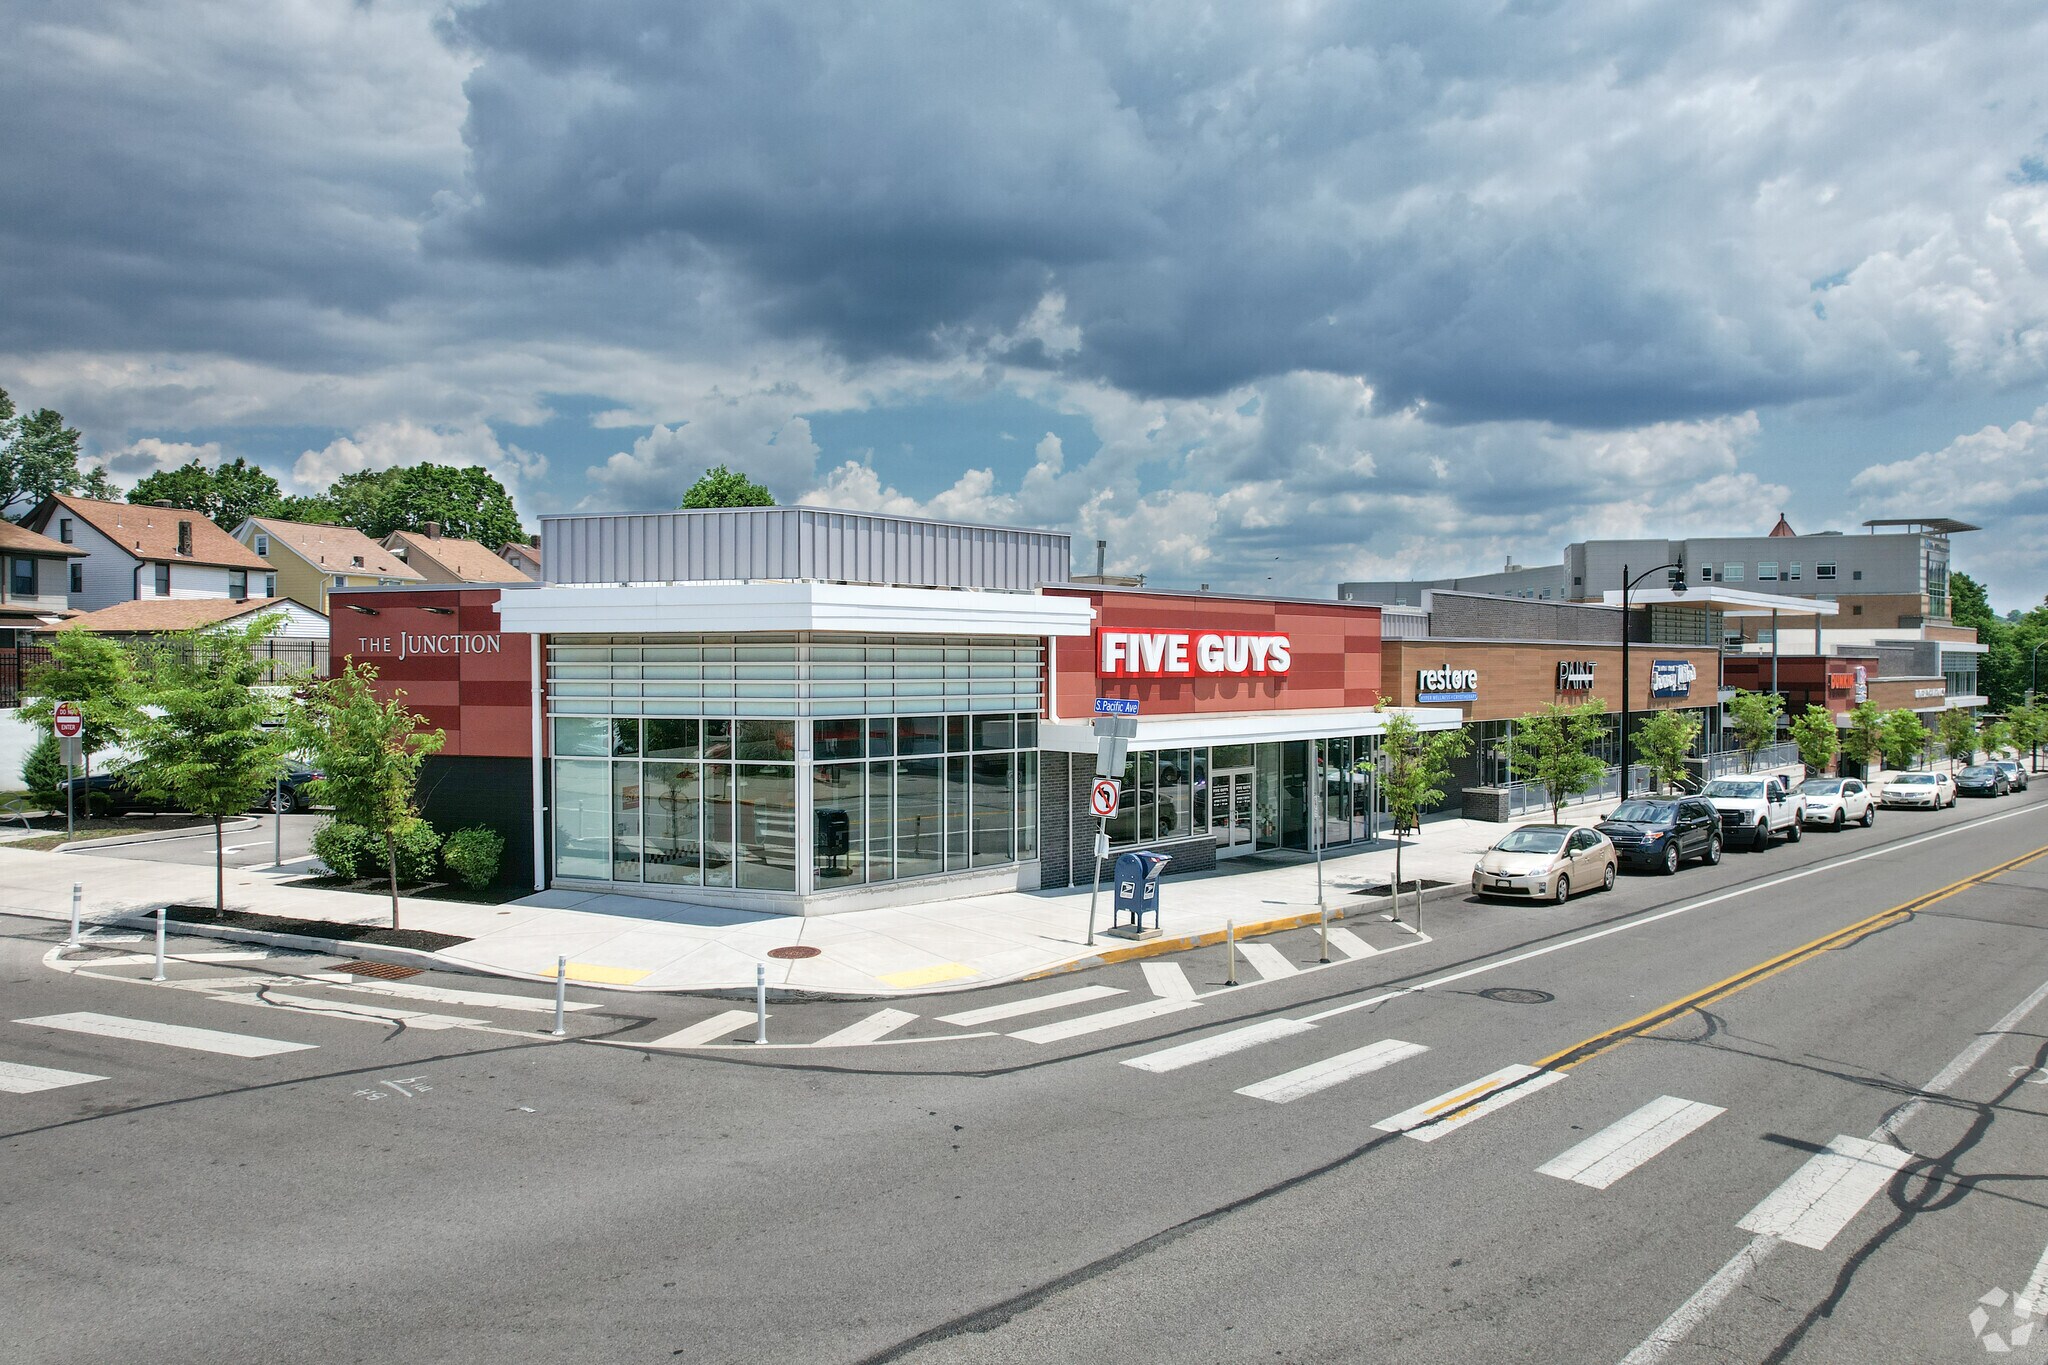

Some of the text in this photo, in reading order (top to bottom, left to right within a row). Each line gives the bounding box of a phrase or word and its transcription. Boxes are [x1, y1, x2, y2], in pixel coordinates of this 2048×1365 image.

[358, 631, 501, 661] THE JUNCTION
[1101, 632, 1291, 673] FIVE GUYS
[1418, 664, 1478, 690] restore
[1558, 661, 1598, 690] PAINT
[1095, 700, 1138, 713] S. Pacific Ave
